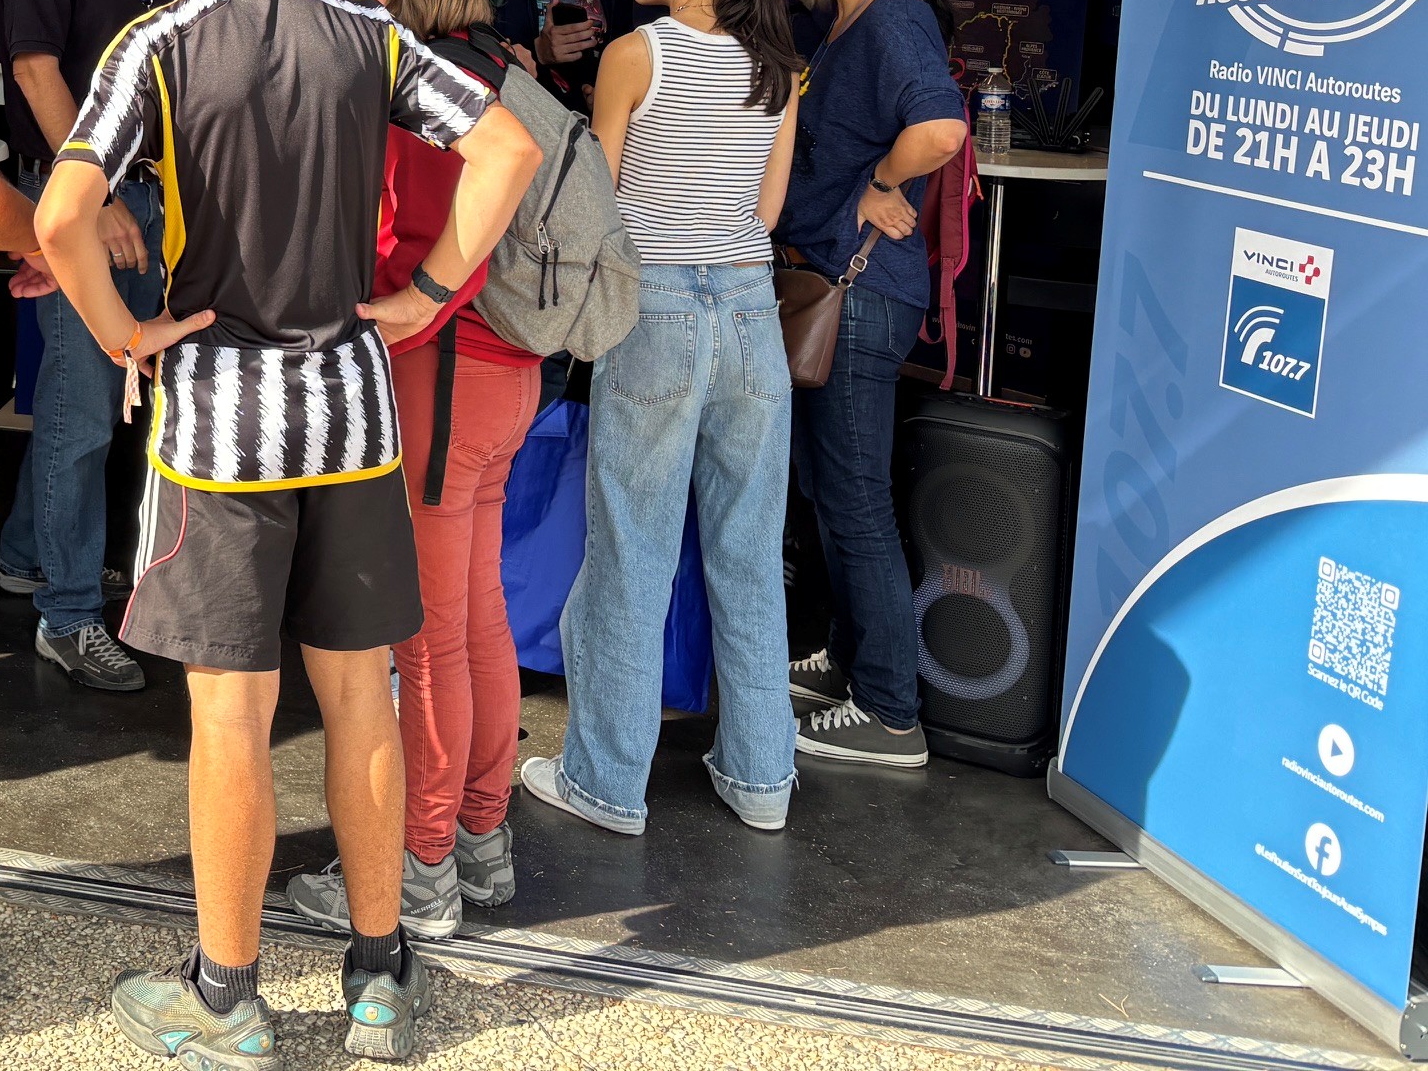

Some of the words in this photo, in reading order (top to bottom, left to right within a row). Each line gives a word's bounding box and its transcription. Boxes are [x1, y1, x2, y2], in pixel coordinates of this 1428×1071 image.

[1210, 60, 1252, 84] Radio
[1256, 64, 1301, 90] VINCI
[1305, 70, 1401, 104] Autoroutes
[1190, 90, 1222, 118] DU
[1226, 97, 1298, 132] LUNDI
[1304, 107, 1339, 139] AU
[1344, 114, 1420, 151] JEUDI
[1186, 119, 1224, 160] DE
[1233, 127, 1298, 174] 21H
[1306, 140, 1331, 181] A
[1340, 145, 1416, 196] 23H
[1243, 249, 1294, 272] VINCI
[1264, 268, 1299, 283] AUTOROUTES
[1258, 351, 1311, 381] 107.7
[1307, 663, 1339, 689] Scannez
[1339, 678, 1347, 693] le
[1347, 683, 1362, 700] QR
[1361, 690, 1384, 711] Code
[1281, 756, 1385, 823] radiovinciautoroutes.com
[410, 898, 443, 916] MERRELL
